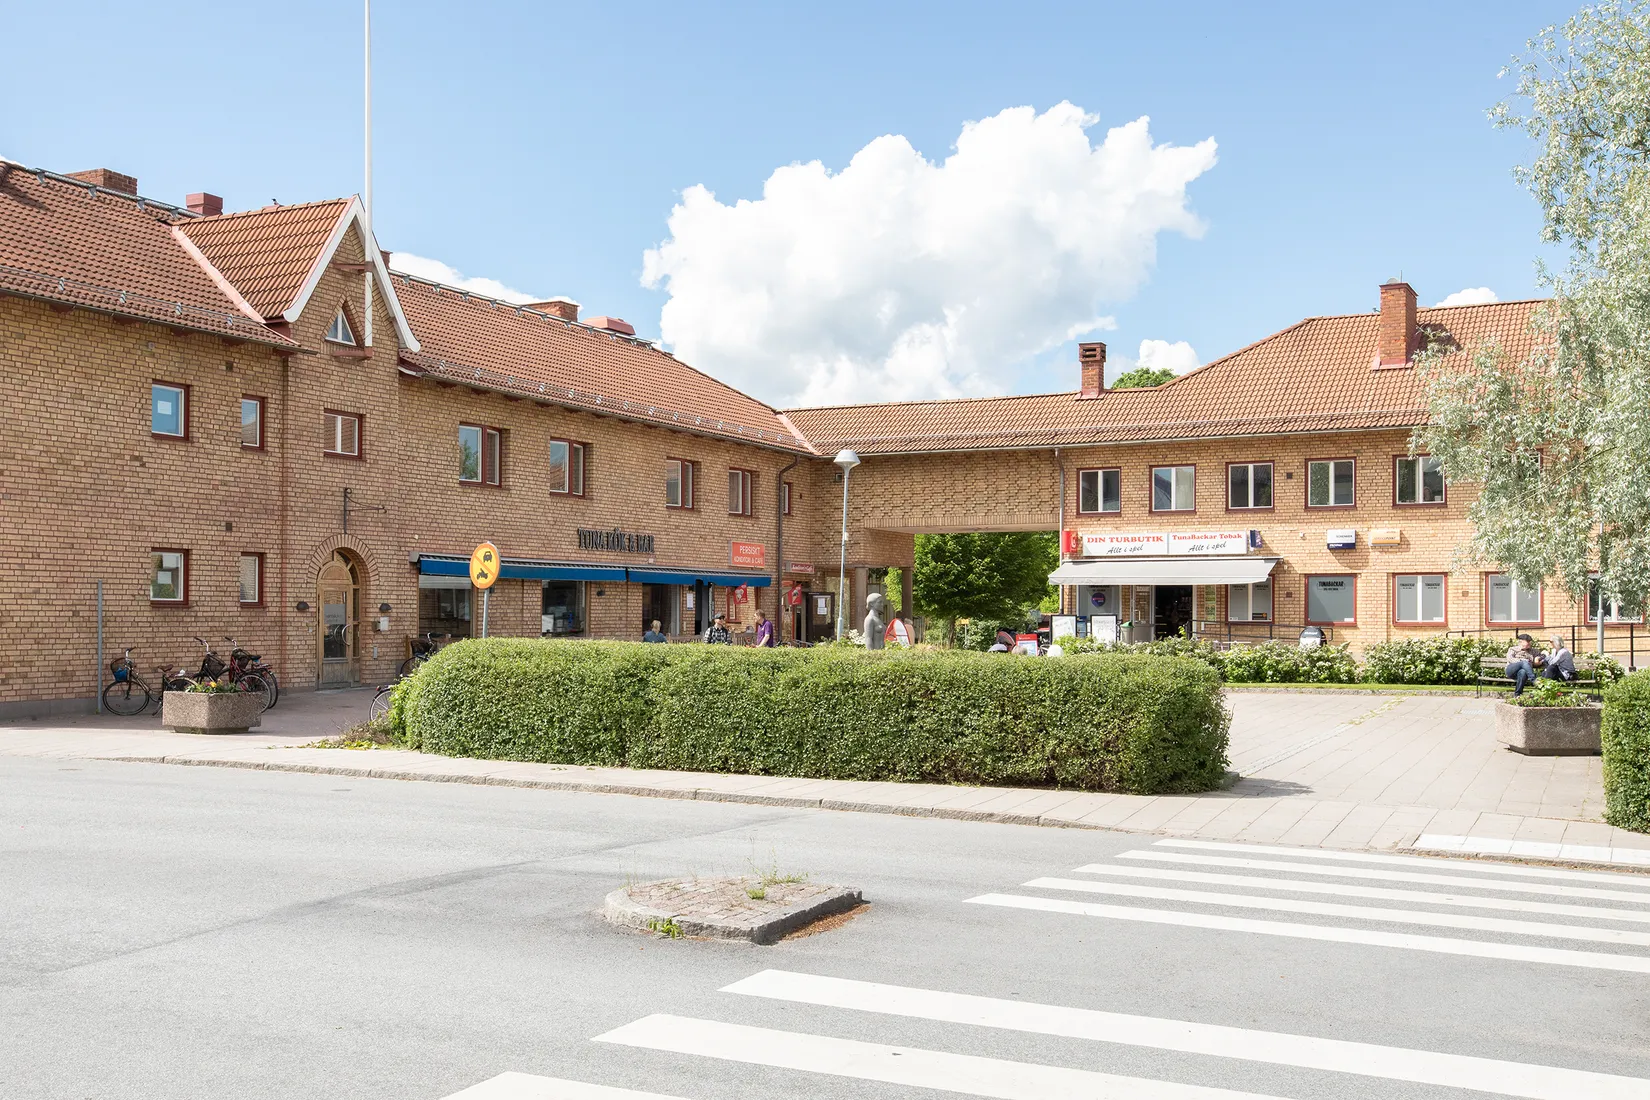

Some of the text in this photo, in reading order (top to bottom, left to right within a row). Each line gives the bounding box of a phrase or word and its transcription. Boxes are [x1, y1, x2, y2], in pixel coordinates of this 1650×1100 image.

[578, 527, 655, 553] TUNA KÖK & BAR
[1109, 535, 1164, 543] TURBUTIK
[739, 545, 761, 555] PERSISKT
[1106, 546, 1122, 554] Allt
[1129, 544, 1144, 553] spel
[1188, 544, 1204, 553] Allt
[1211, 541, 1227, 550] spel
